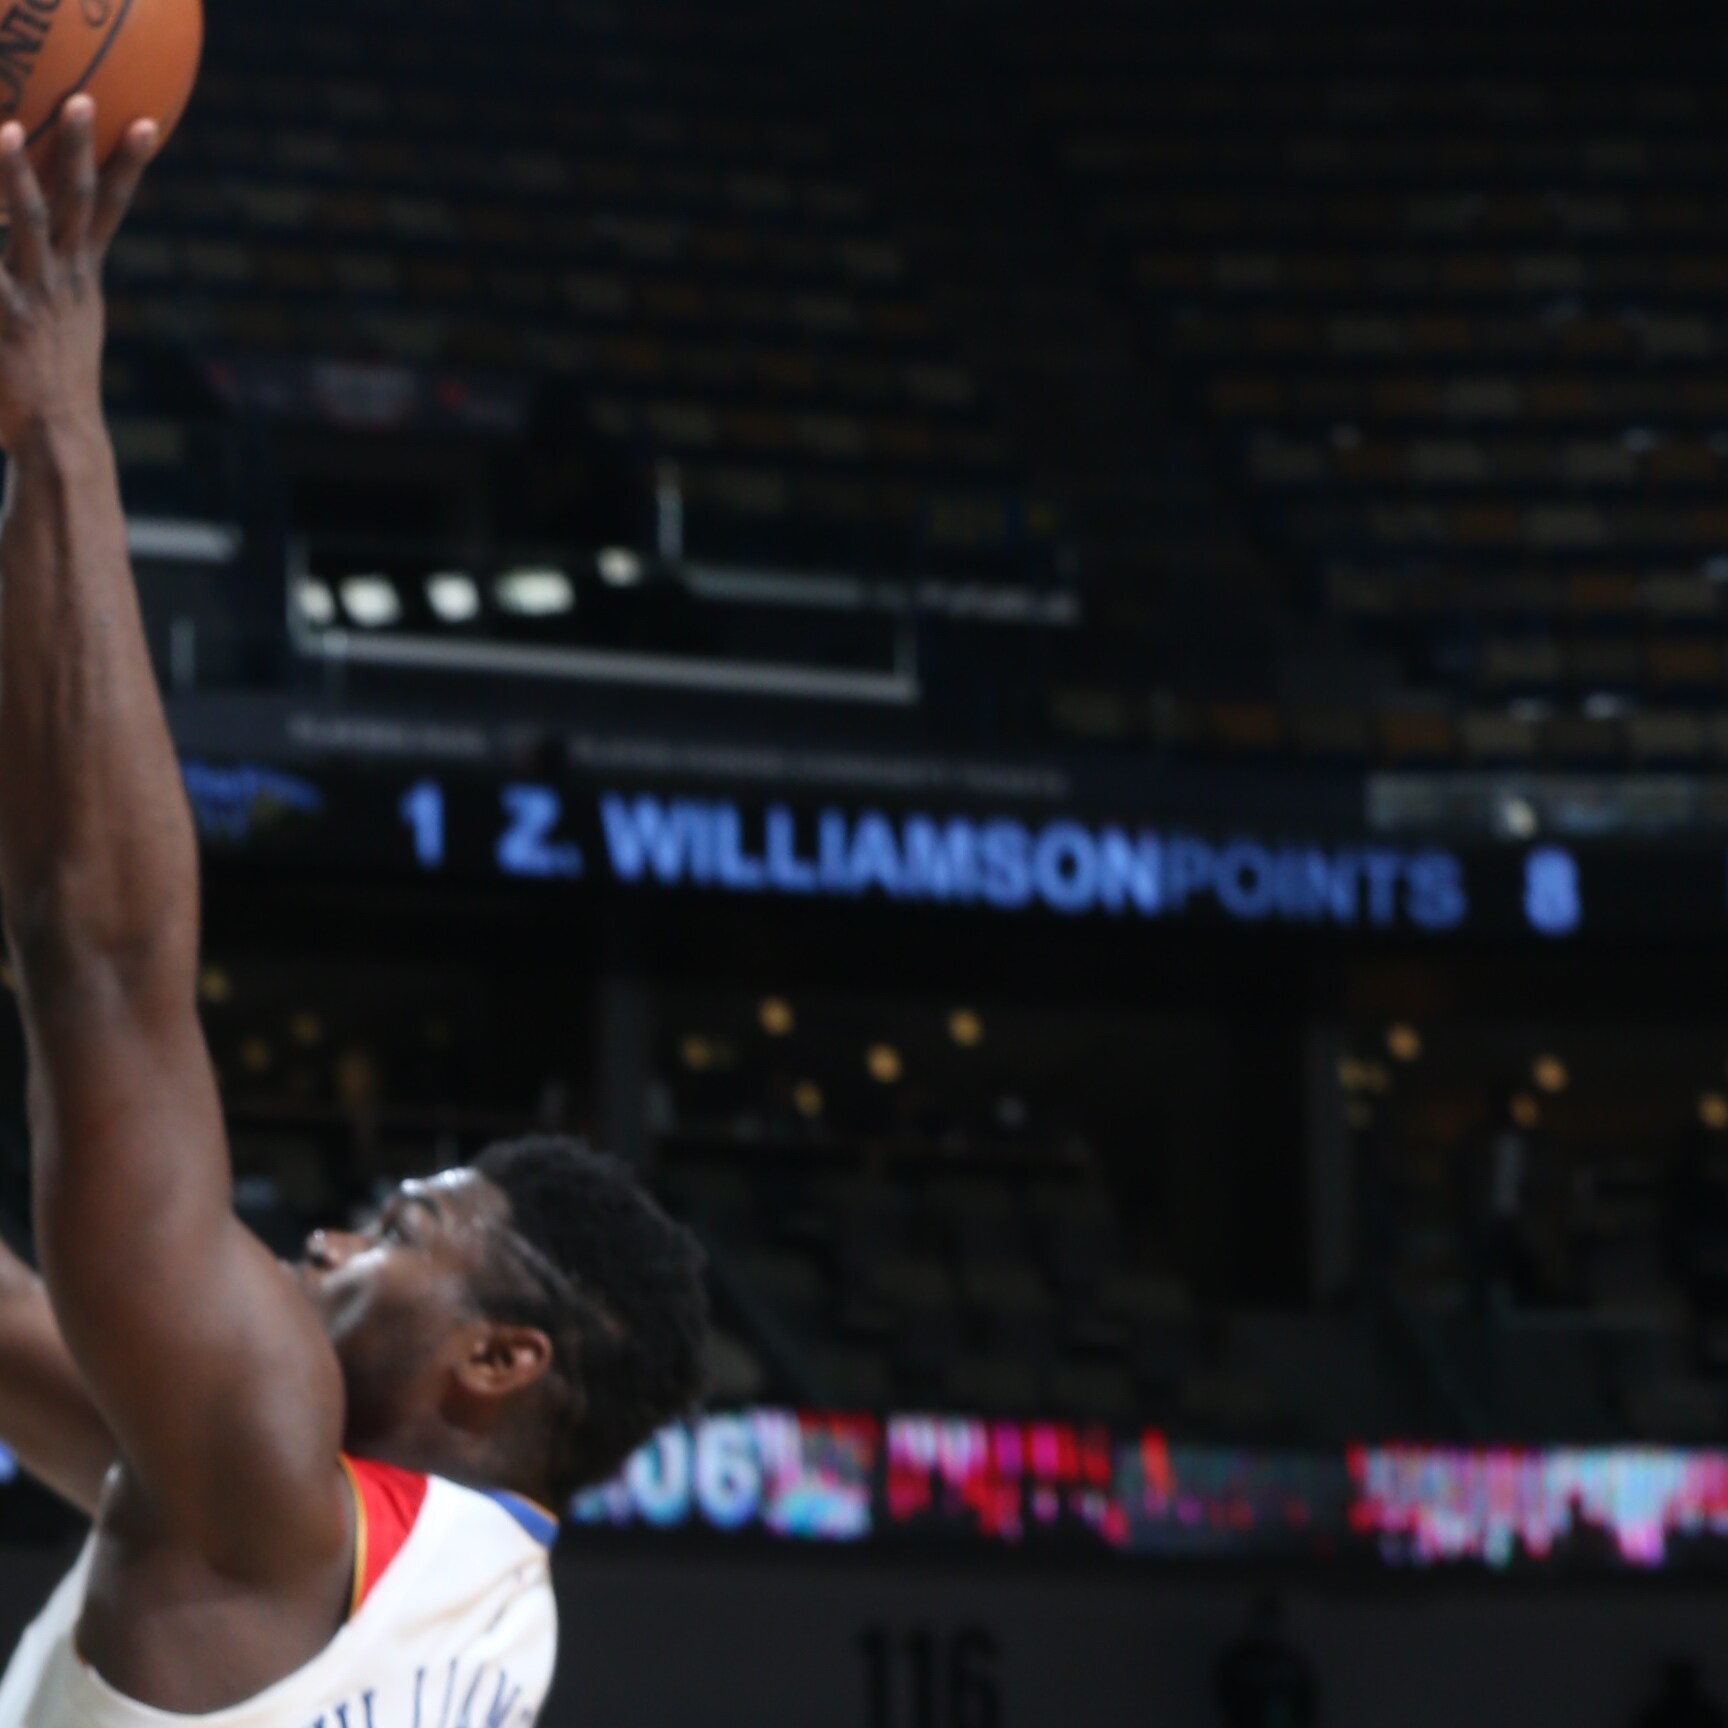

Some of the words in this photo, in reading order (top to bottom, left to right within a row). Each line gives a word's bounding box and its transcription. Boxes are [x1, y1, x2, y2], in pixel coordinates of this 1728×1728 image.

[401, 780, 444, 868] 1
[600, 792, 1160, 916] WILLIAMSON
[1160, 832, 1466, 932] POINTS
[1523, 846, 1583, 936] 8
